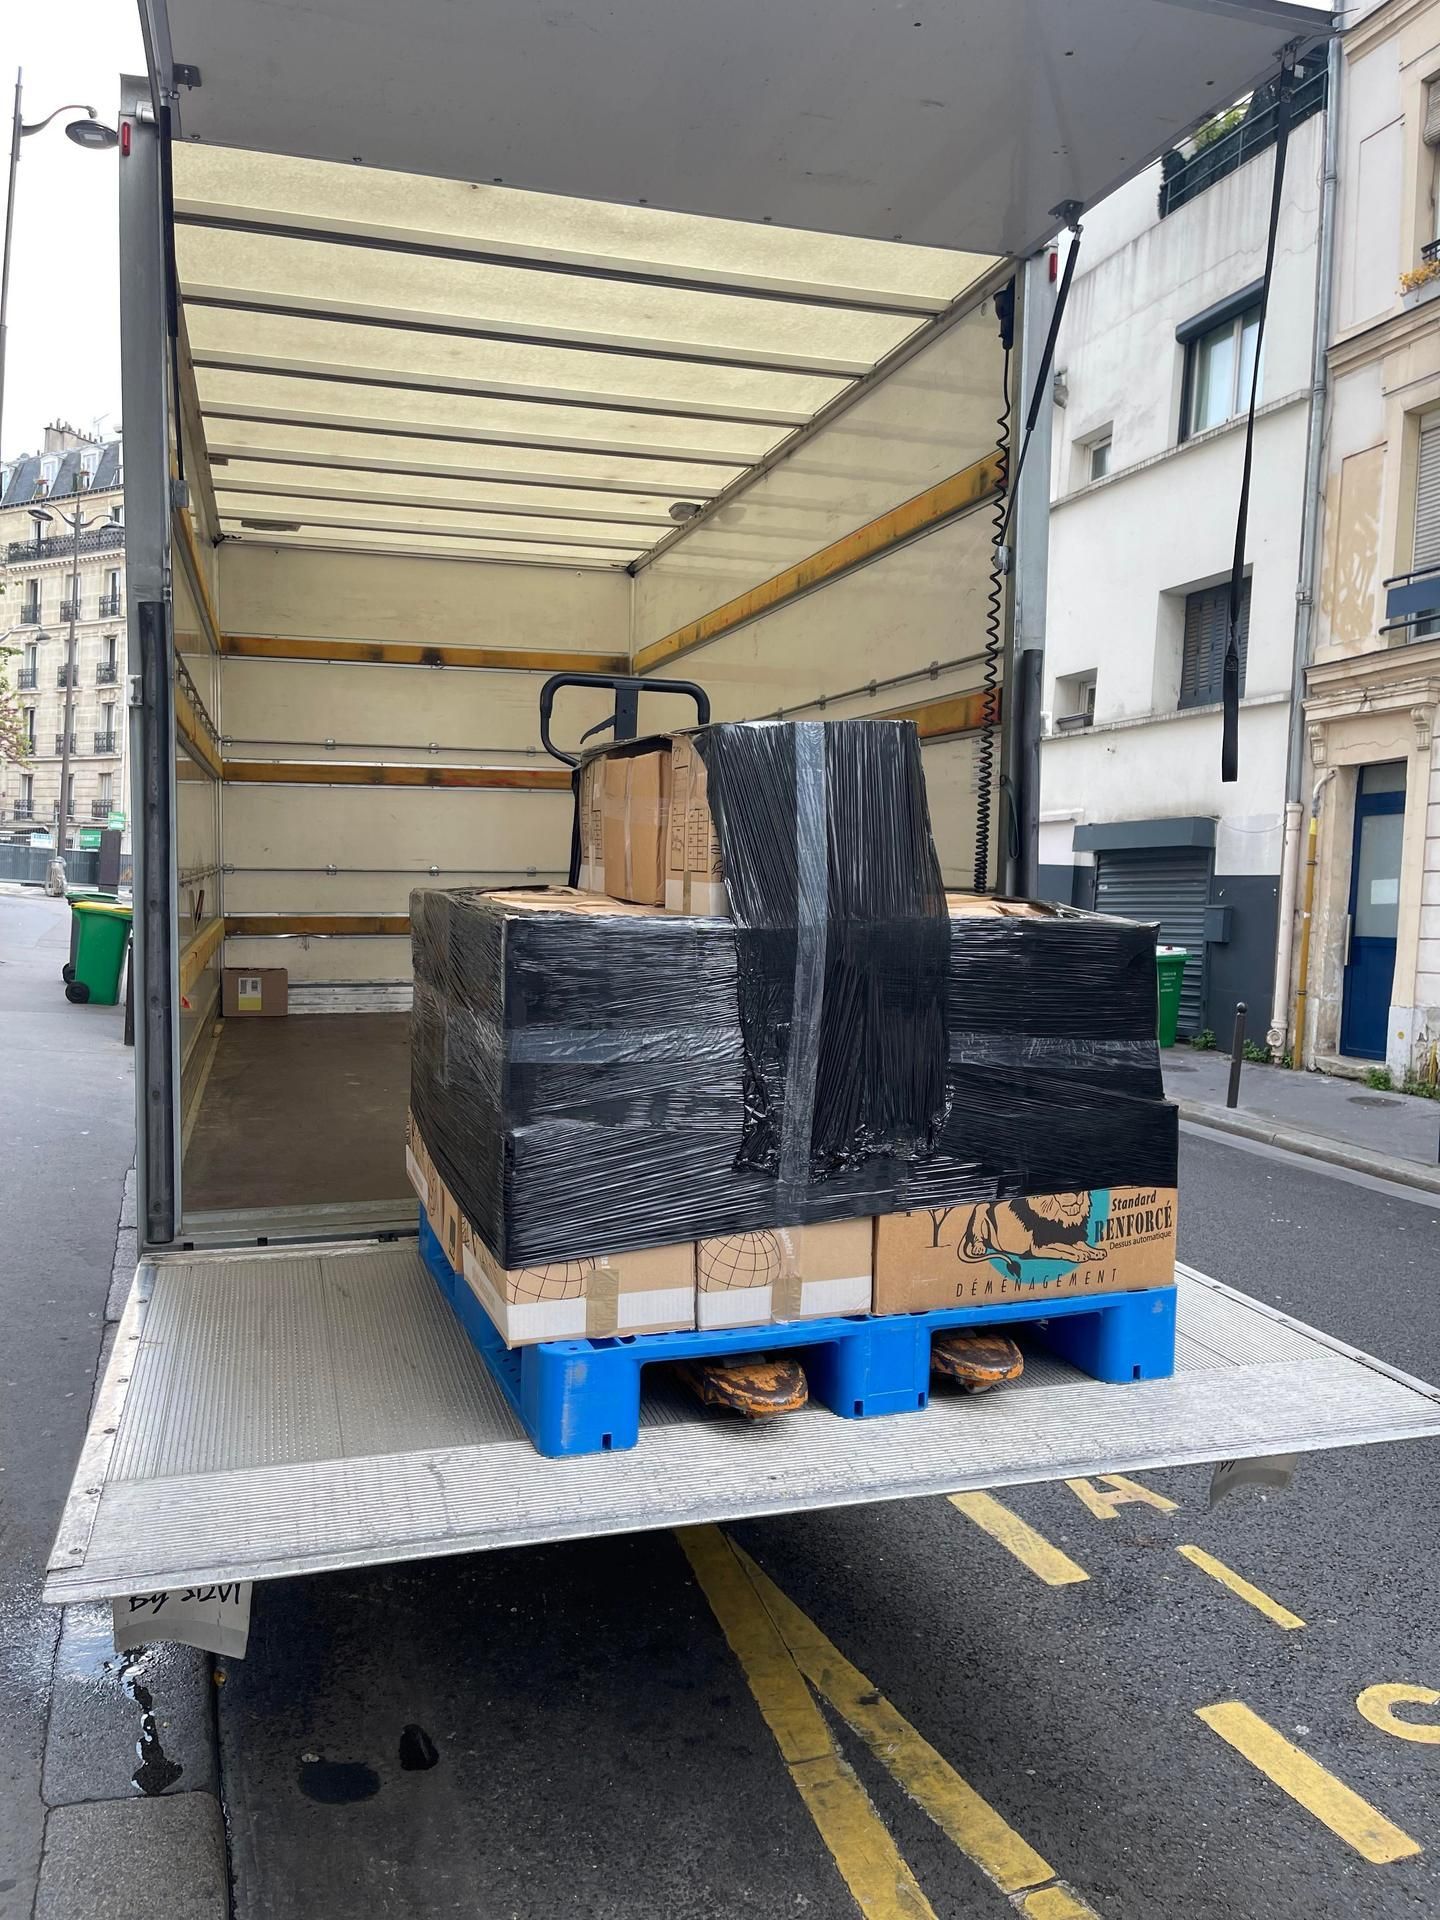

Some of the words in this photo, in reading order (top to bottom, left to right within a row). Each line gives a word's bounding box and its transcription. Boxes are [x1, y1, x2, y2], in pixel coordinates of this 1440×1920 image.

[1111, 1189, 1157, 1212] Standard
[1094, 1200, 1173, 1243] RENFORCÉ
[1109, 1239, 1132, 1250] Dessus
[1133, 1230, 1172, 1246] automatique
[956, 1268, 1117, 1298] DÉMÉNAGEMENT
